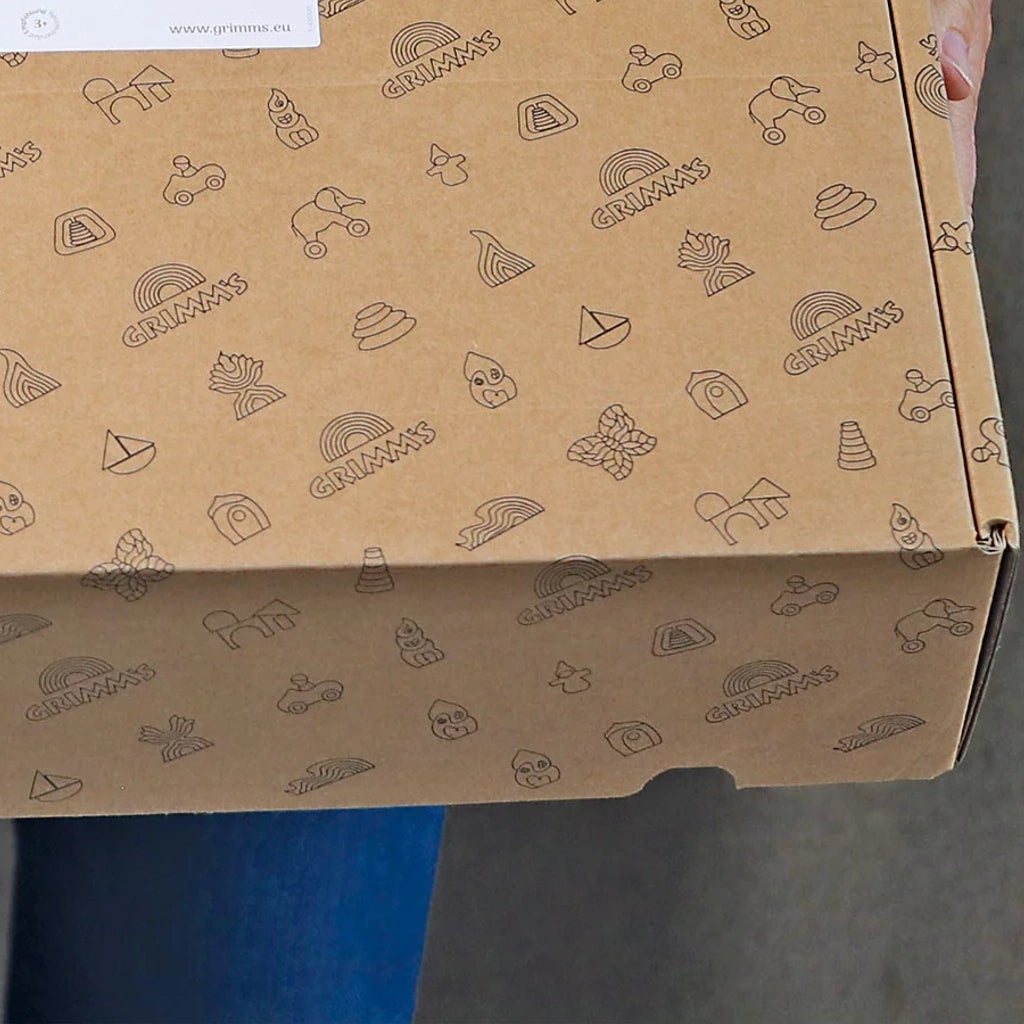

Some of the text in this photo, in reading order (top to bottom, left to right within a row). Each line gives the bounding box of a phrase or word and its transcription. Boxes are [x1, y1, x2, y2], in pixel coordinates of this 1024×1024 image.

[169, 23, 292, 36] www.grimms.eu
[381, 30, 501, 99] GRIMM'S
[591, 157, 711, 230] GRIMM'S
[122, 273, 248, 348] GRIMM'S
[783, 300, 904, 376] GRIMM'S
[309, 421, 436, 499] GRIMM'S
[518, 564, 653, 627] GRIMM'S
[25, 664, 156, 722] GRIMM'S
[705, 664, 839, 724] GRIMM'S
